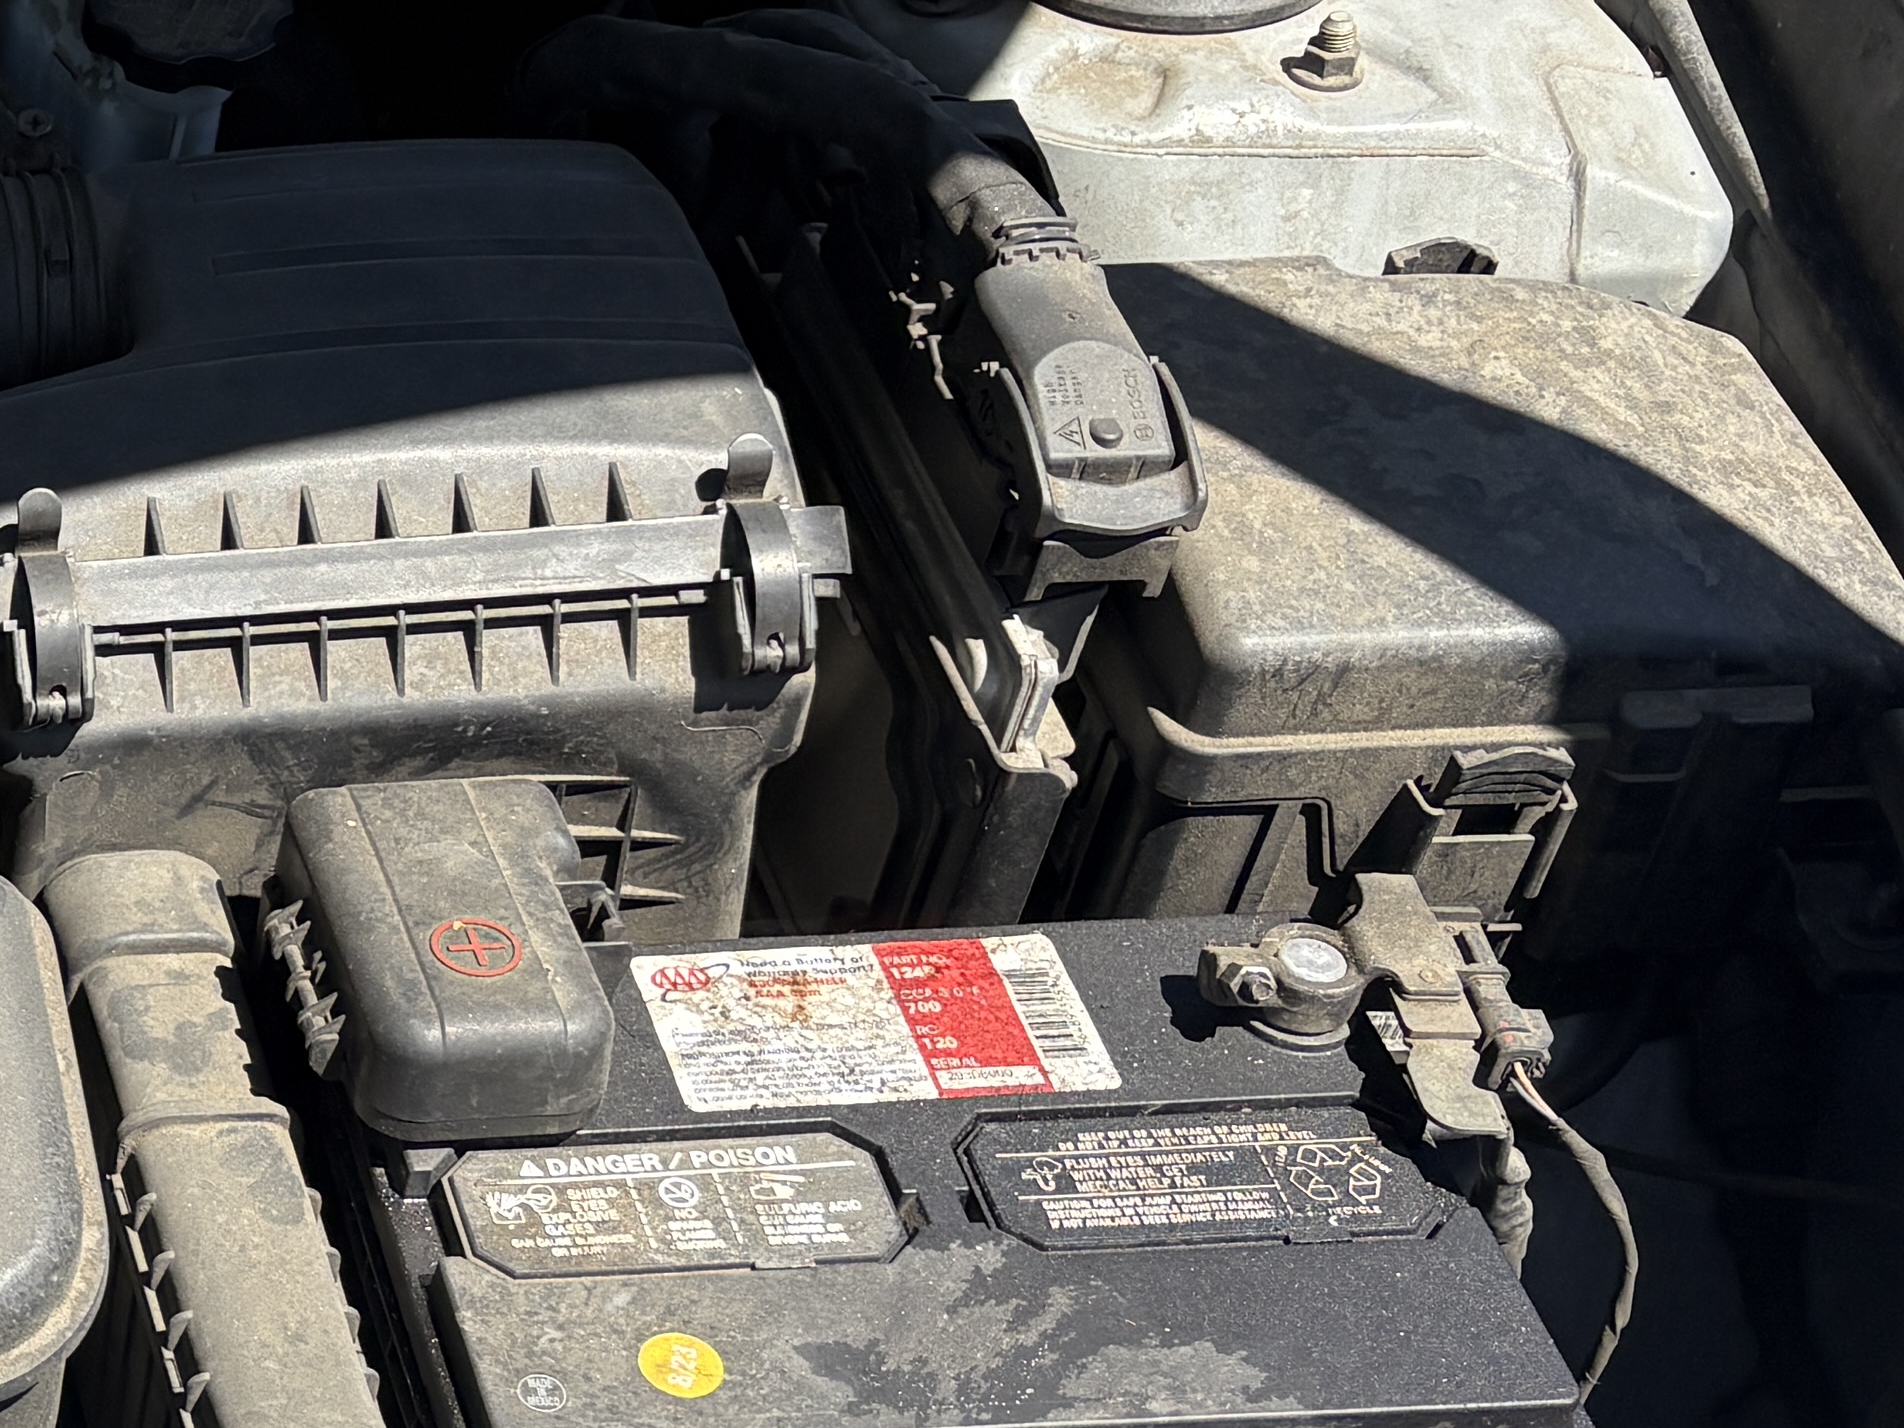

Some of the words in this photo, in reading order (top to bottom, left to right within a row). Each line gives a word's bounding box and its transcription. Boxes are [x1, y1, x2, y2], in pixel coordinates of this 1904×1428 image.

[656, 967, 708, 991] AAA
[904, 1000, 942, 1015] 700
[915, 1024, 940, 1036] RC
[921, 1036, 959, 1051] 120
[1107, 1129, 1130, 1140] OUT
[1150, 1128, 1173, 1138] THE
[1175, 1126, 1211, 1137] REACH
[1232, 1123, 1289, 1134] CHILDREN
[1058, 1141, 1075, 1151] DO
[1076, 1140, 1099, 1150] NOT
[1257, 1131, 1281, 1141] AND
[1283, 1129, 1318, 1141] LEVEL
[545, 1152, 664, 1177] DANGER
[689, 1145, 797, 1169] POISON
[1064, 1157, 1108, 1170] FLUSH
[1109, 1155, 1144, 1168] EYES
[1148, 1149, 1235, 1165] IMMEDIATELY
[1069, 1168, 1106, 1182] WITH
[1163, 1164, 1189, 1177] GET
[1137, 1177, 1173, 1190] HELP
[1174, 1174, 1208, 1188] FAST
[566, 1186, 619, 1201] SHIELD
[1093, 1197, 1116, 1209] FOR
[1144, 1194, 1173, 1206] JUMP
[1174, 1191, 1226, 1204] STARTING
[1227, 1190, 1271, 1202] FOLLOW
[570, 1199, 609, 1212] EYES
[755, 1201, 827, 1216] SULFURIC
[829, 1198, 863, 1213] ACID
[1047, 1207, 1122, 1220] INSTRUCTIONS
[542, 1208, 620, 1225] EXPLOSIVE
[1062, 1217, 1084, 1229] NOT
[1085, 1215, 1141, 1228] AVAILABLE
[1169, 1210, 1213, 1223] SERVICE
[544, 1223, 595, 1236] GASES
[667, 1344, 698, 1390] 8/23
[527, 1378, 553, 1390] MADE
[537, 1388, 546, 1397] IN
[526, 1396, 560, 1407] MEXICO
